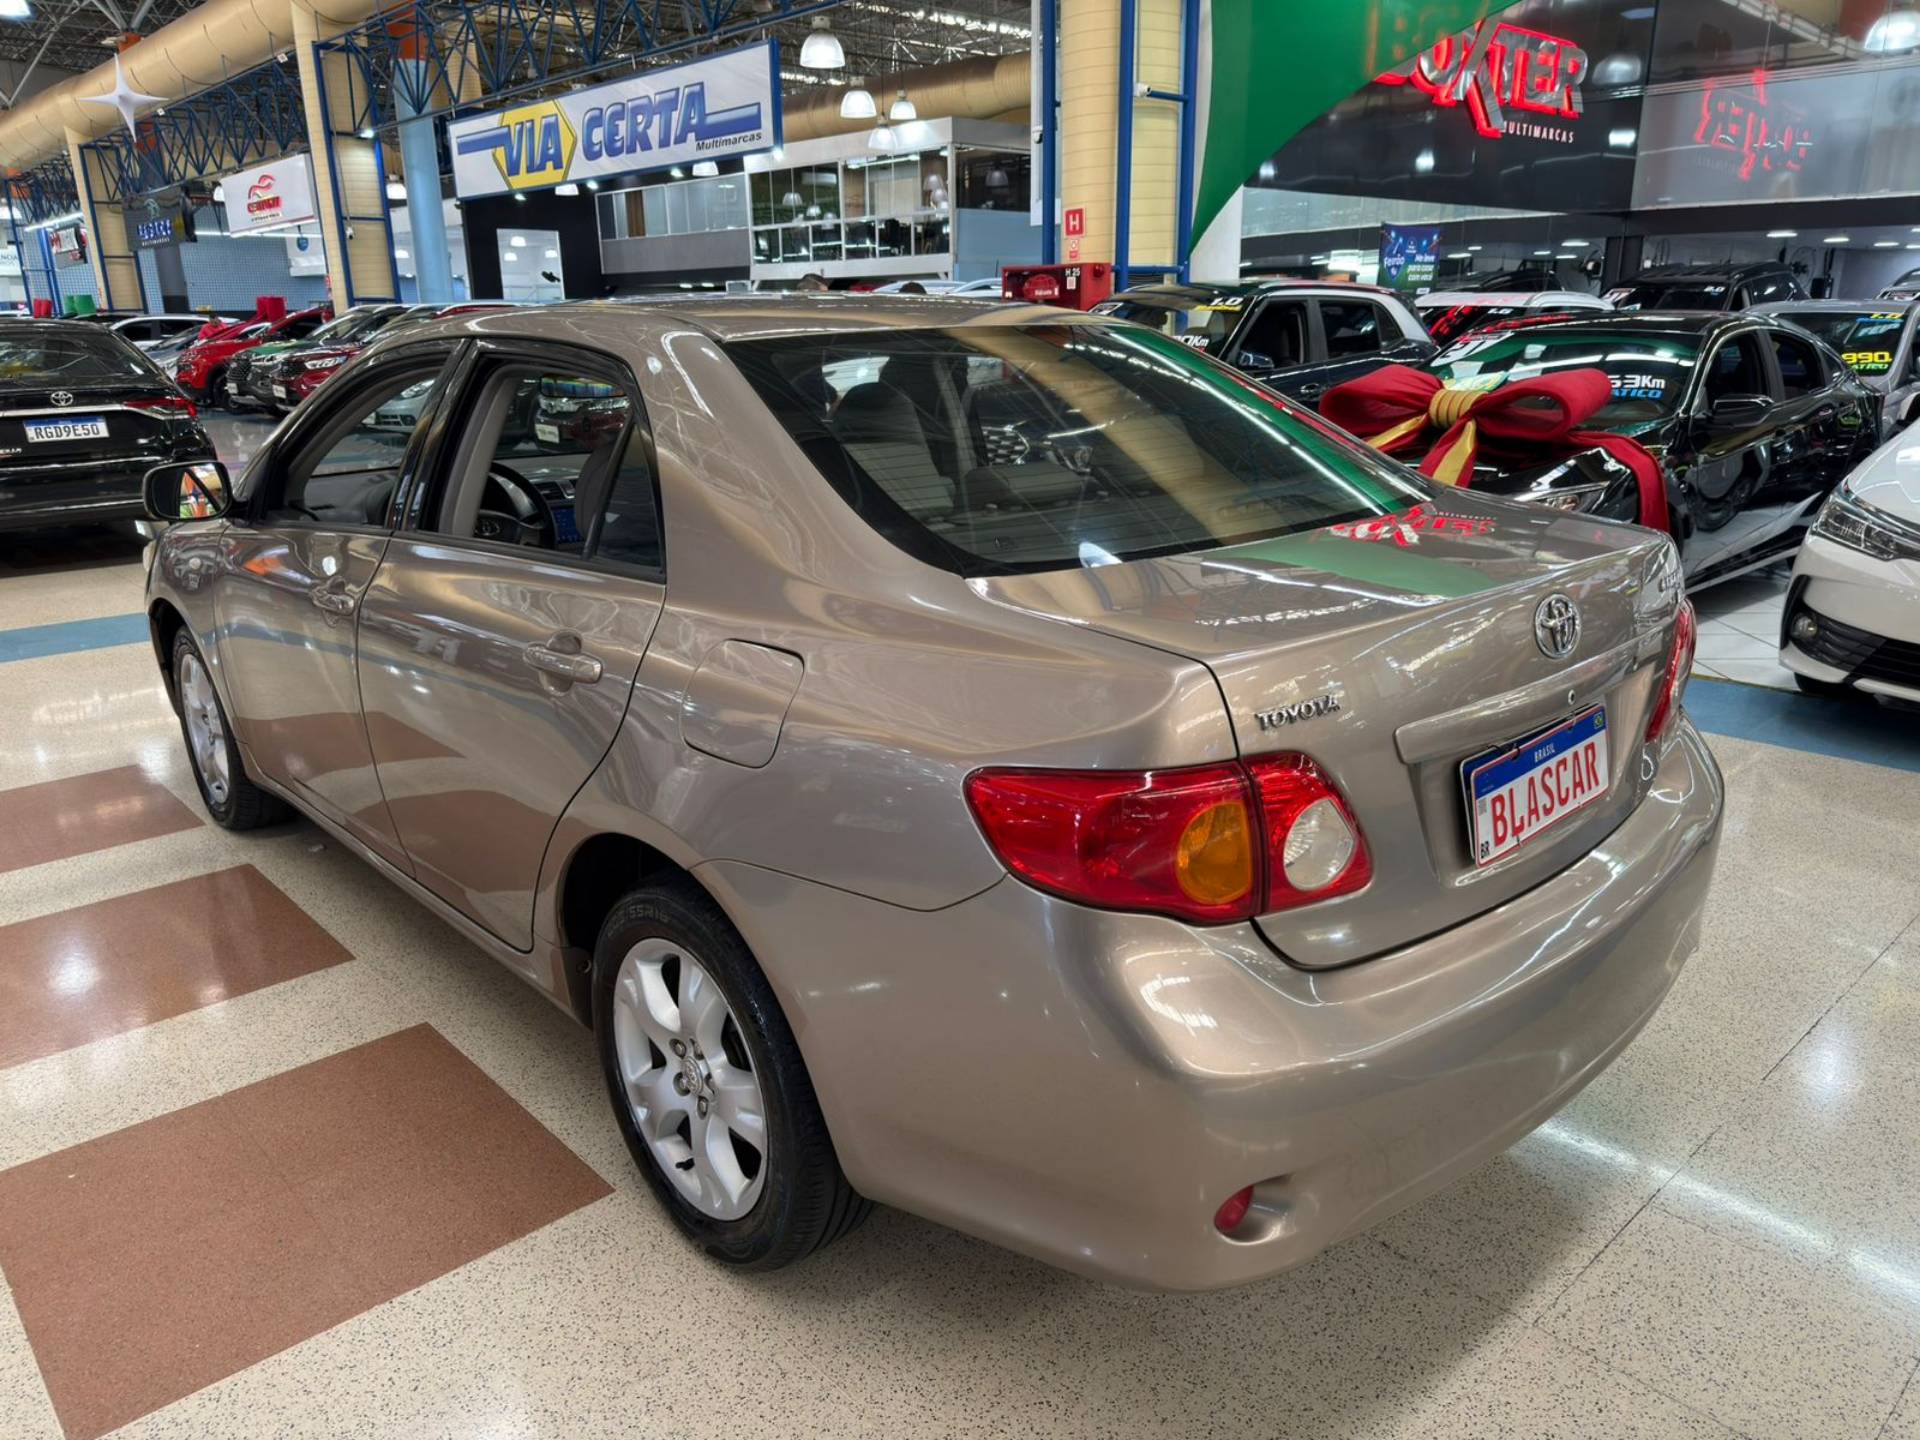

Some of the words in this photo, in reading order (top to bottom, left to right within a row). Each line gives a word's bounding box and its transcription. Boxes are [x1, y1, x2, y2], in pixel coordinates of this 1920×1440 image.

[501, 113, 564, 177] VIA
[582, 82, 706, 162] CERTA
[695, 132, 763, 153] Multimarcas
[1069, 213, 1080, 232] H
[1254, 695, 1341, 731] TOYOTA
[1534, 743, 1556, 763] BRASIL
[1490, 741, 1600, 847] BLASCAR
